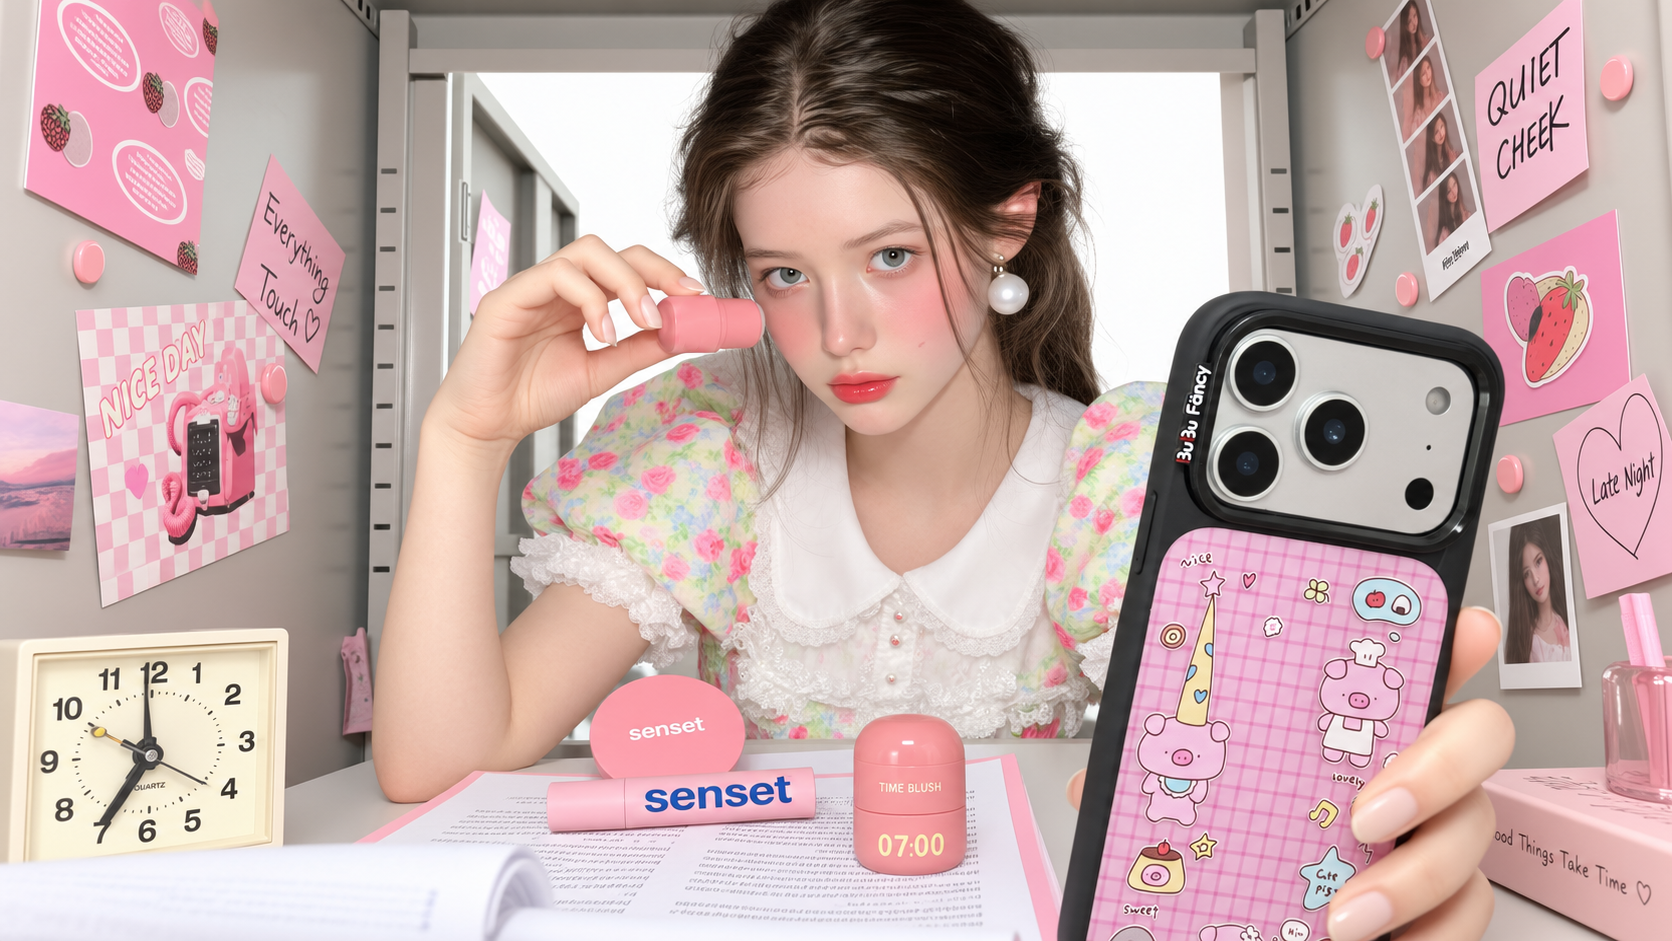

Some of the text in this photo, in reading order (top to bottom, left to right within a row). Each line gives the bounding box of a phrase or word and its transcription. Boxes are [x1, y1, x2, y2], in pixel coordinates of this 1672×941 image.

[1487, 27, 1570, 127] QUIET
[1496, 94, 1570, 180] CHEEK
[263, 191, 329, 305] Everything
[260, 263, 299, 336] Touch
[99, 319, 206, 439] NICE DAY
[1185, 364, 1212, 415] Fäncy
[1592, 452, 1655, 505] Late Night
[98, 667, 121, 691] 11
[140, 661, 169, 684] 12
[192, 662, 202, 684] 1
[224, 684, 242, 706] 2
[52, 697, 83, 721] 10
[629, 717, 705, 741] senset
[238, 731, 256, 752] 3
[40, 750, 59, 774] 9
[220, 778, 239, 800] 4
[644, 776, 793, 812] senset
[879, 782, 942, 793] TIME BLUSH
[55, 798, 74, 822] 8
[184, 809, 201, 832] 5
[93, 820, 112, 844] 7
[138, 819, 157, 843] 6
[878, 832, 945, 857] 07:00
[1492, 828, 1628, 895] ood Things Take Time
